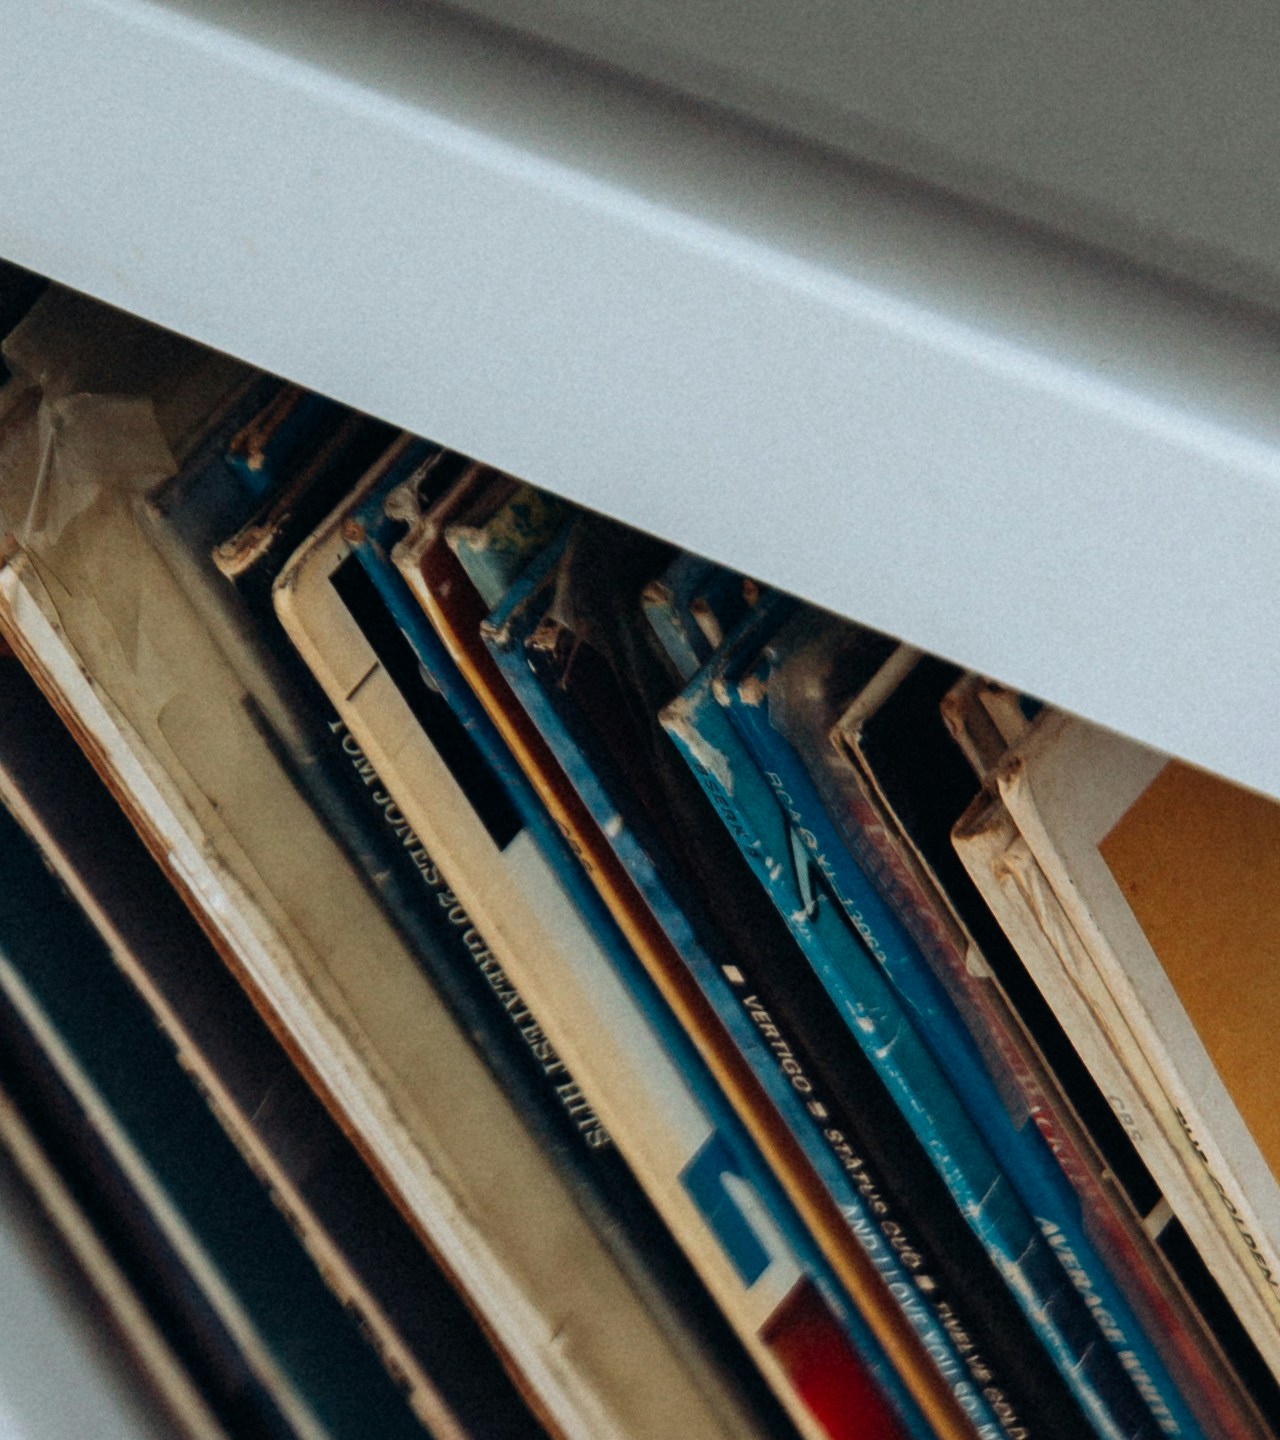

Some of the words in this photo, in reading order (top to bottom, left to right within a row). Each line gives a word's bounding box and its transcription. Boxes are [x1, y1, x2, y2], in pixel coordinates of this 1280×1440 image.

[371, 786, 444, 888] JONES
[433, 886, 470, 928] 20
[458, 925, 565, 1080] GREATEST
[552, 1077, 610, 1151] HITS
[742, 996, 814, 1091] VERTIGO
[983, 1387, 1029, 1438] GOLD
[837, 1203, 882, 1247] AND
[880, 1271, 929, 1324] LOVE
[918, 1331, 959, 1376] YOU
[1206, 1172, 1278, 1286] GOLDEN
[1036, 1221, 1127, 1341] AVERAGE
[1116, 1353, 1182, 1432] WHITE
